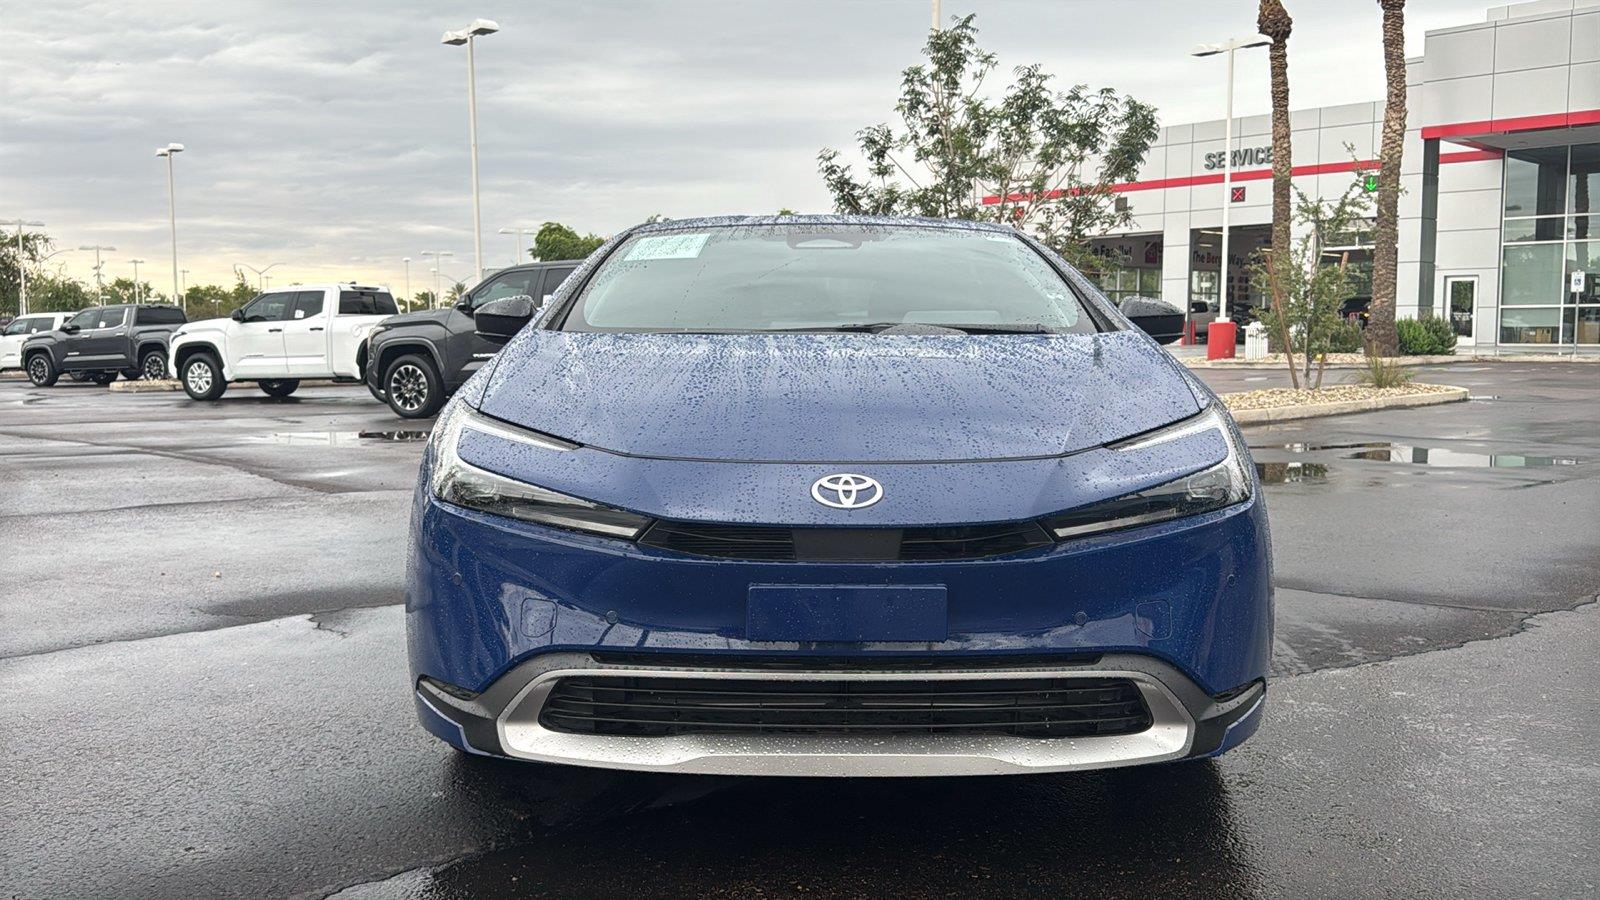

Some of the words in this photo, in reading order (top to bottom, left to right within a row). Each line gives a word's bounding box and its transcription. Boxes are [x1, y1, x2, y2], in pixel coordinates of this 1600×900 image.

[1204, 146, 1273, 170] SERVICE
[1193, 250, 1205, 264] The
[1206, 252, 1223, 268] Berg
